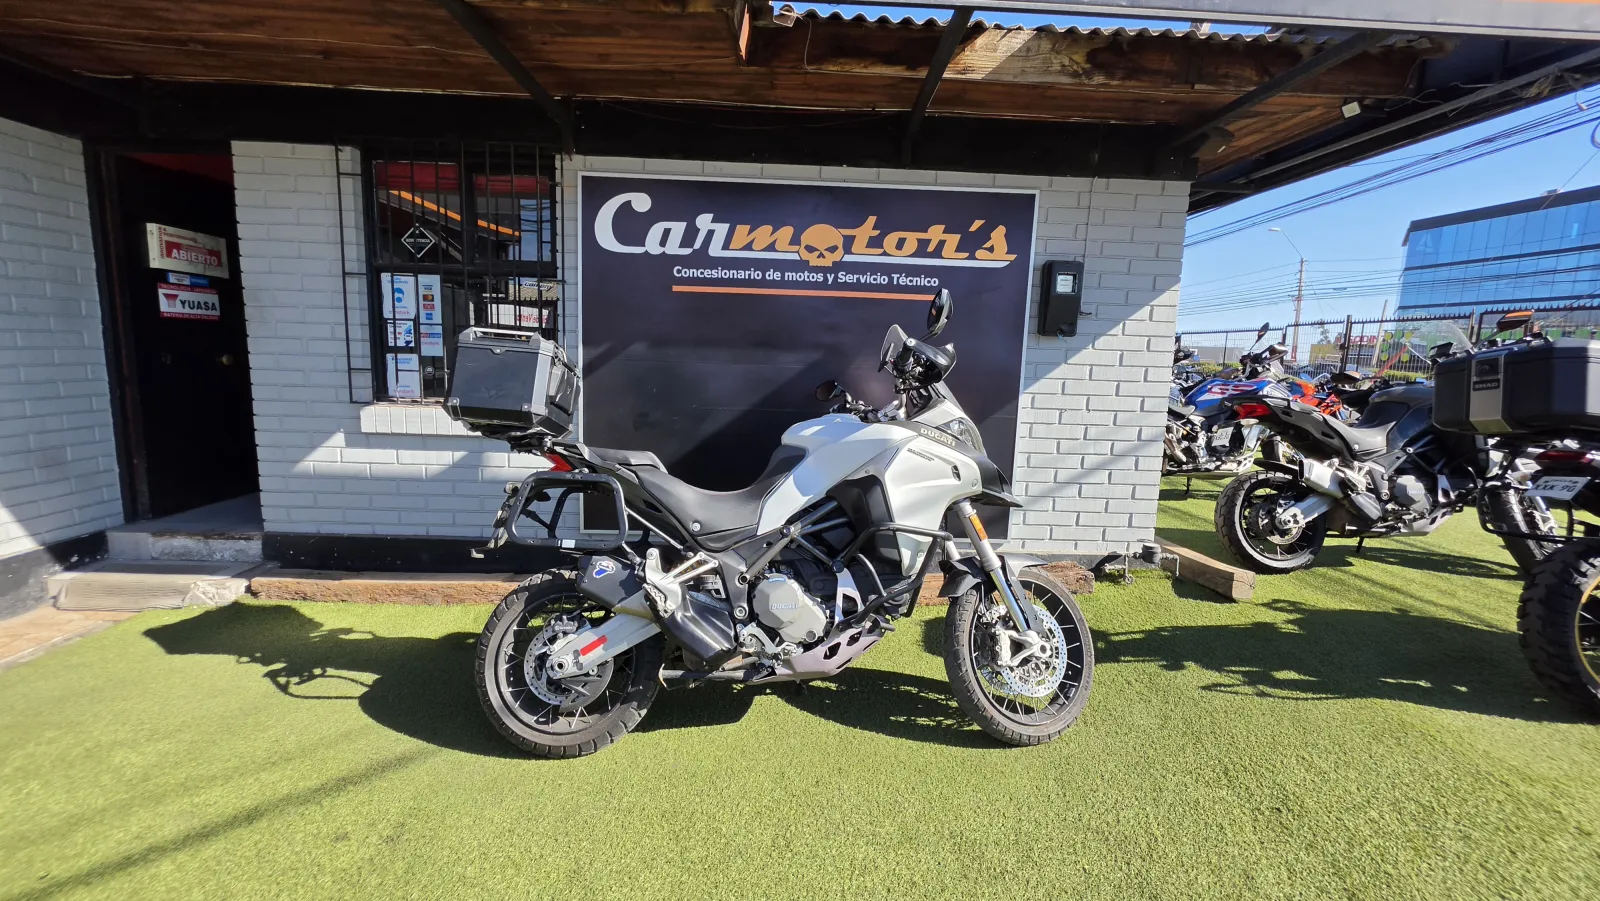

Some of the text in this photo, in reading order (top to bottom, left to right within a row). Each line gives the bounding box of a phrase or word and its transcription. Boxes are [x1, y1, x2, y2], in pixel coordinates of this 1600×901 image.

[171, 248, 218, 266] ABIERTO
[673, 265, 939, 287] Concesionario de motos y Servicio Técnico
[179, 299, 218, 312] YUASA
[920, 427, 957, 448] DUCATI
